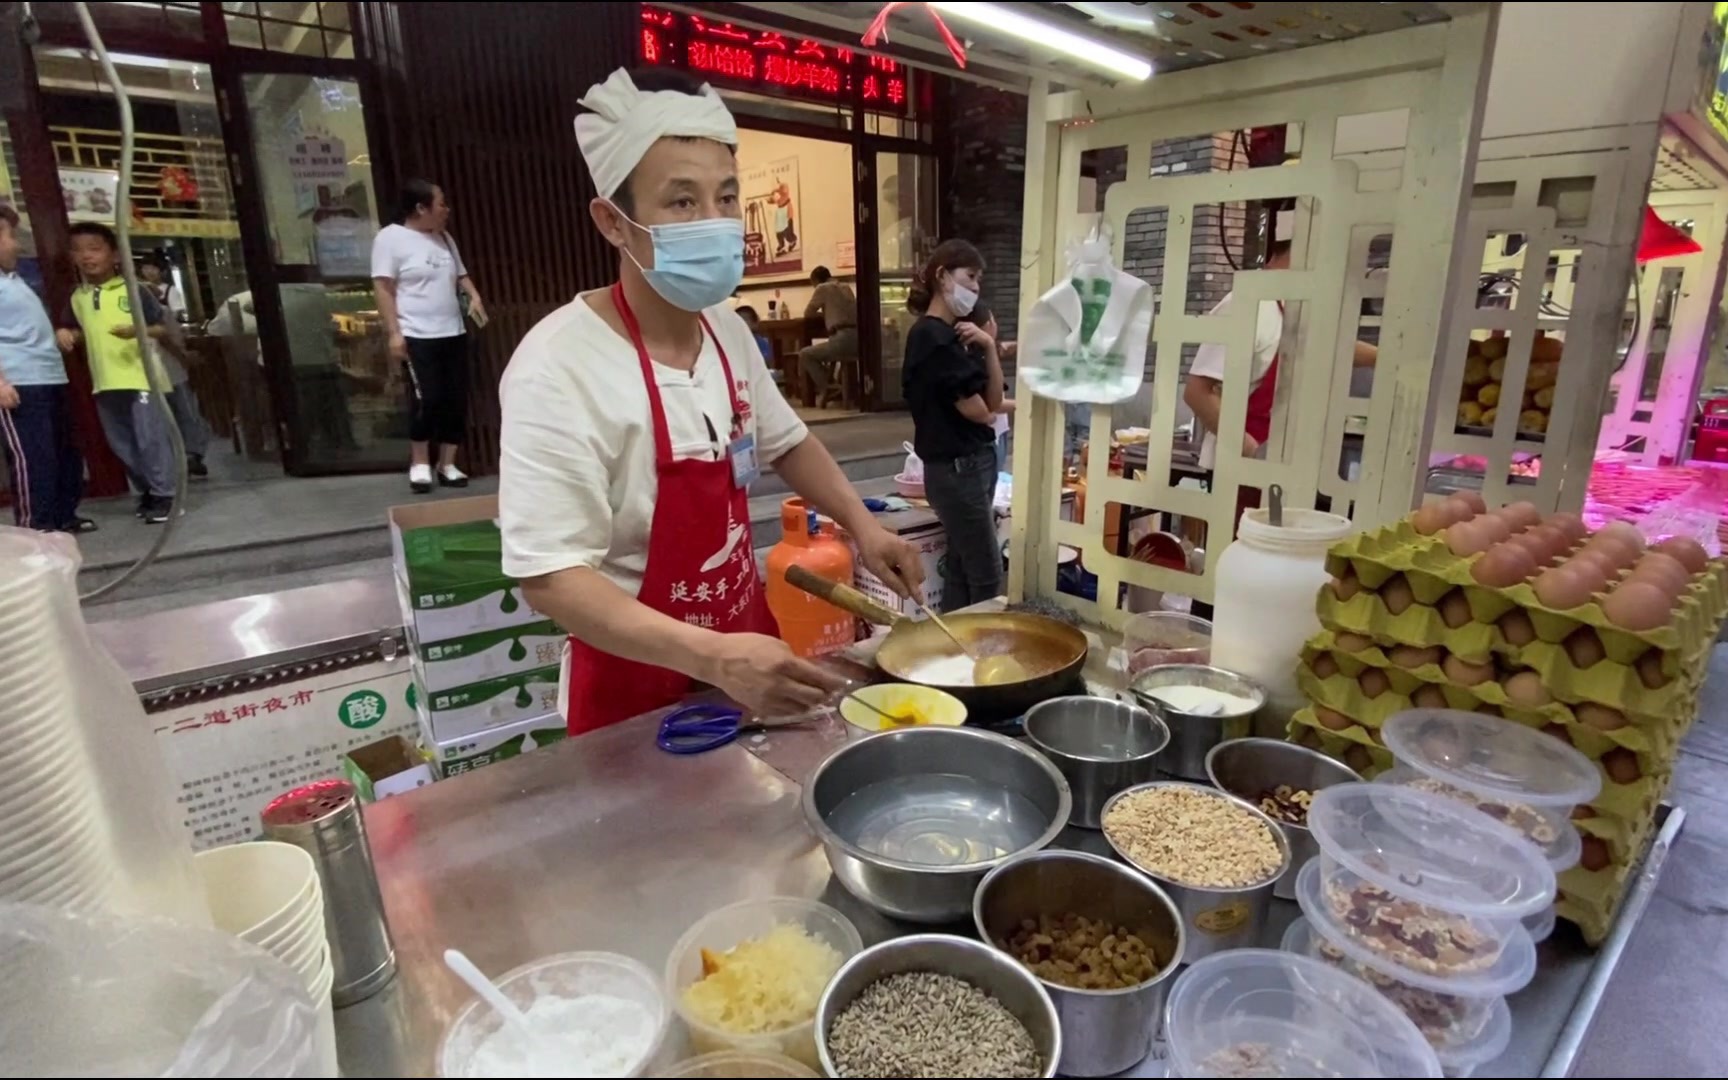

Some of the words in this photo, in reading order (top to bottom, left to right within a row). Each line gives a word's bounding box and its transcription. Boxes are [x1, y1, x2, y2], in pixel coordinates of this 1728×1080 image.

[172, 690, 314, 734] 二道街夜市
[346, 695, 382, 726] 酸
